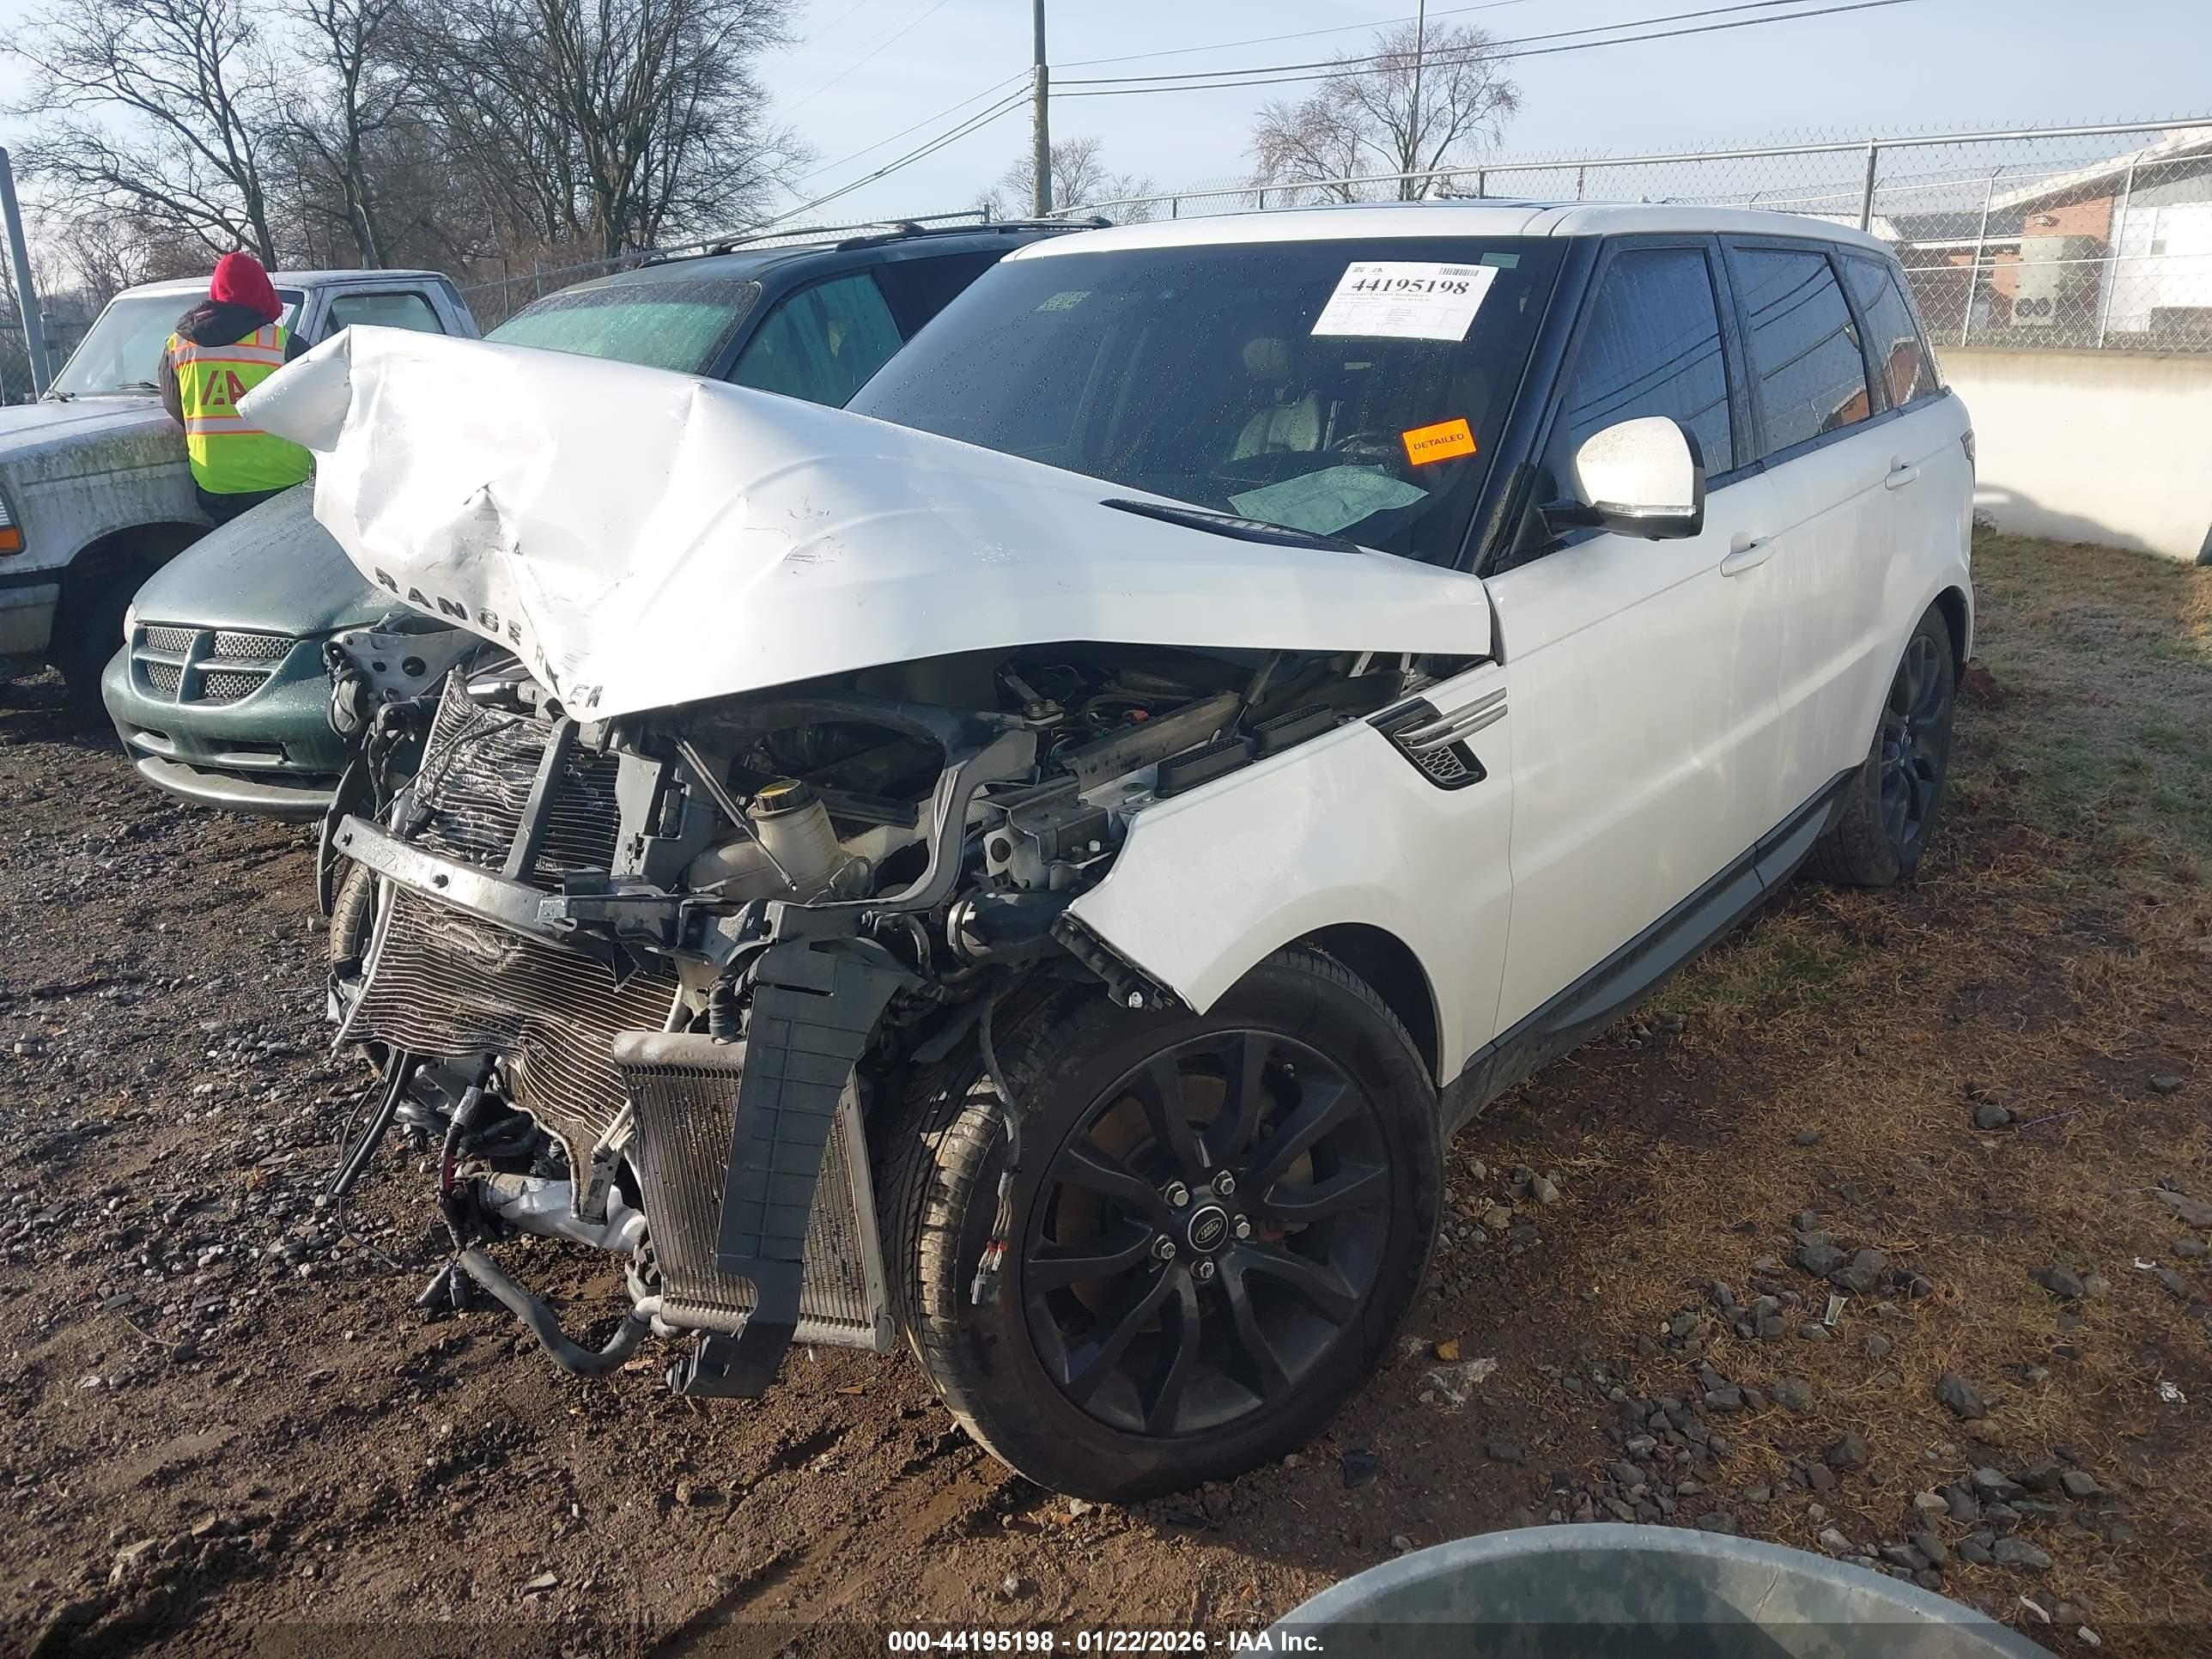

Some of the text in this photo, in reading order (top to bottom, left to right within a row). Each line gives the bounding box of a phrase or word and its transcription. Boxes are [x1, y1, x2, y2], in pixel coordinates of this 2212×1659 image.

[1352, 278, 1470, 295] 44195198
[1413, 433, 1465, 450] DETAILED
[374, 566, 521, 646] RANGE
